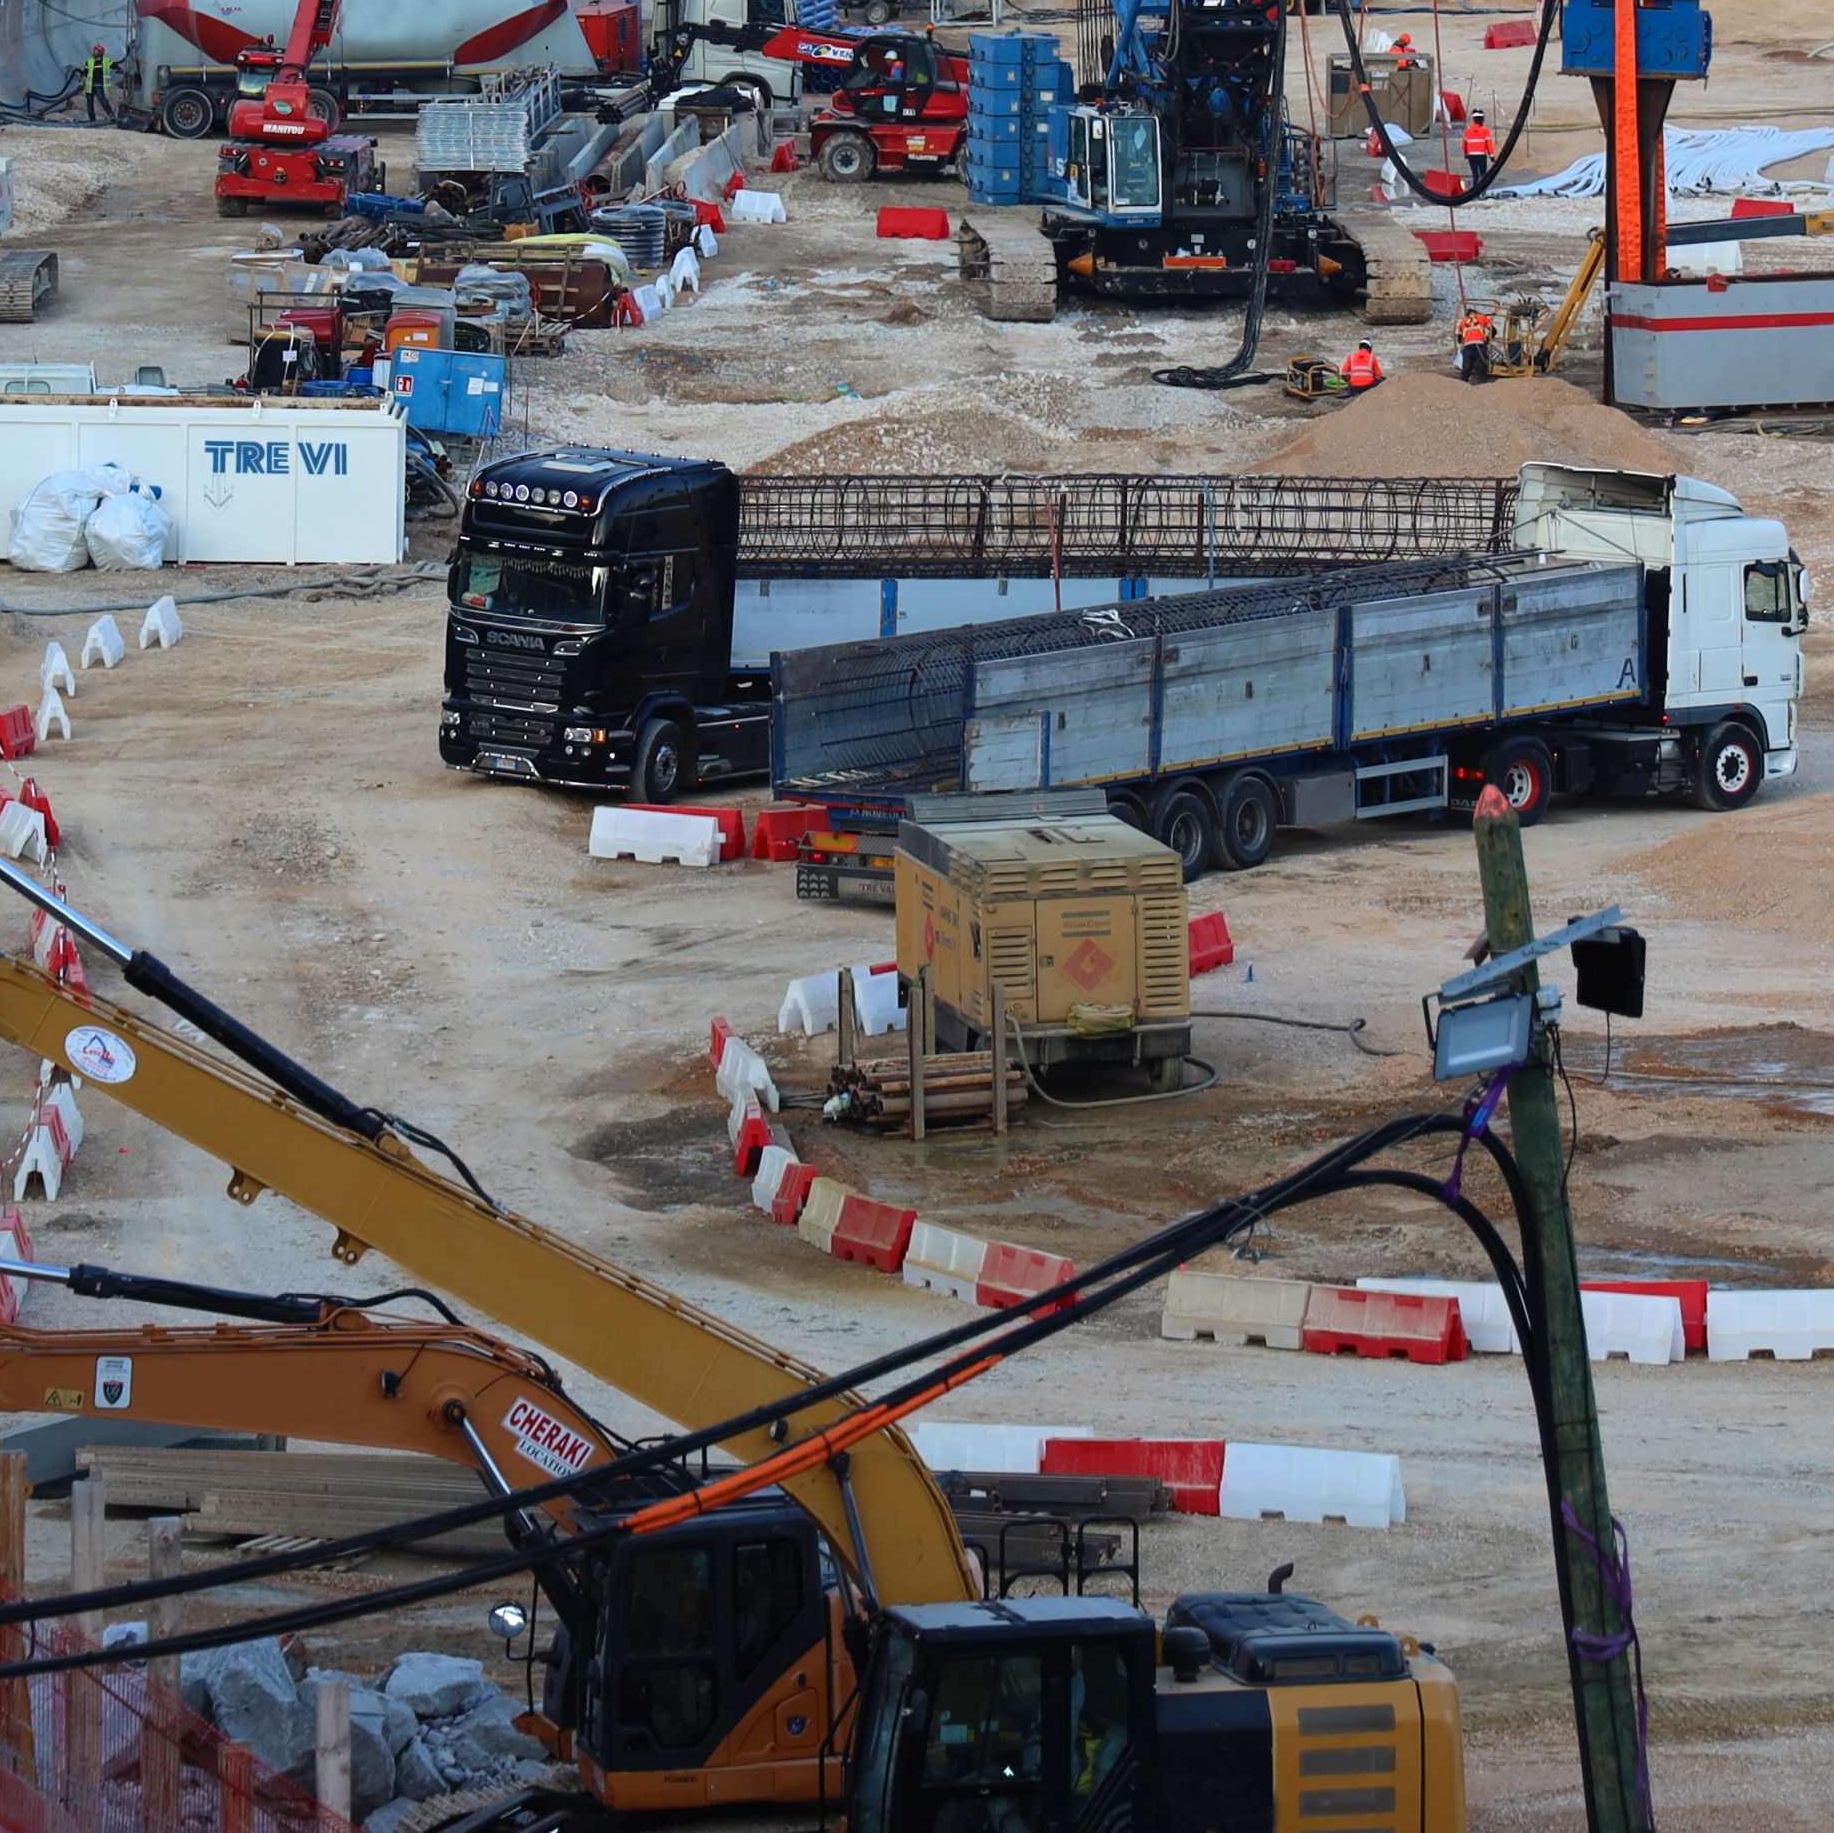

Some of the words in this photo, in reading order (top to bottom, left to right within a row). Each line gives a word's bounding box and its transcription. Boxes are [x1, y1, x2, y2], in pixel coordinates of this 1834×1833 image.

[262, 124, 305, 135] MANITOU
[486, 630, 545, 650] SCANIA
[509, 1402, 591, 1468] CHERAKI
